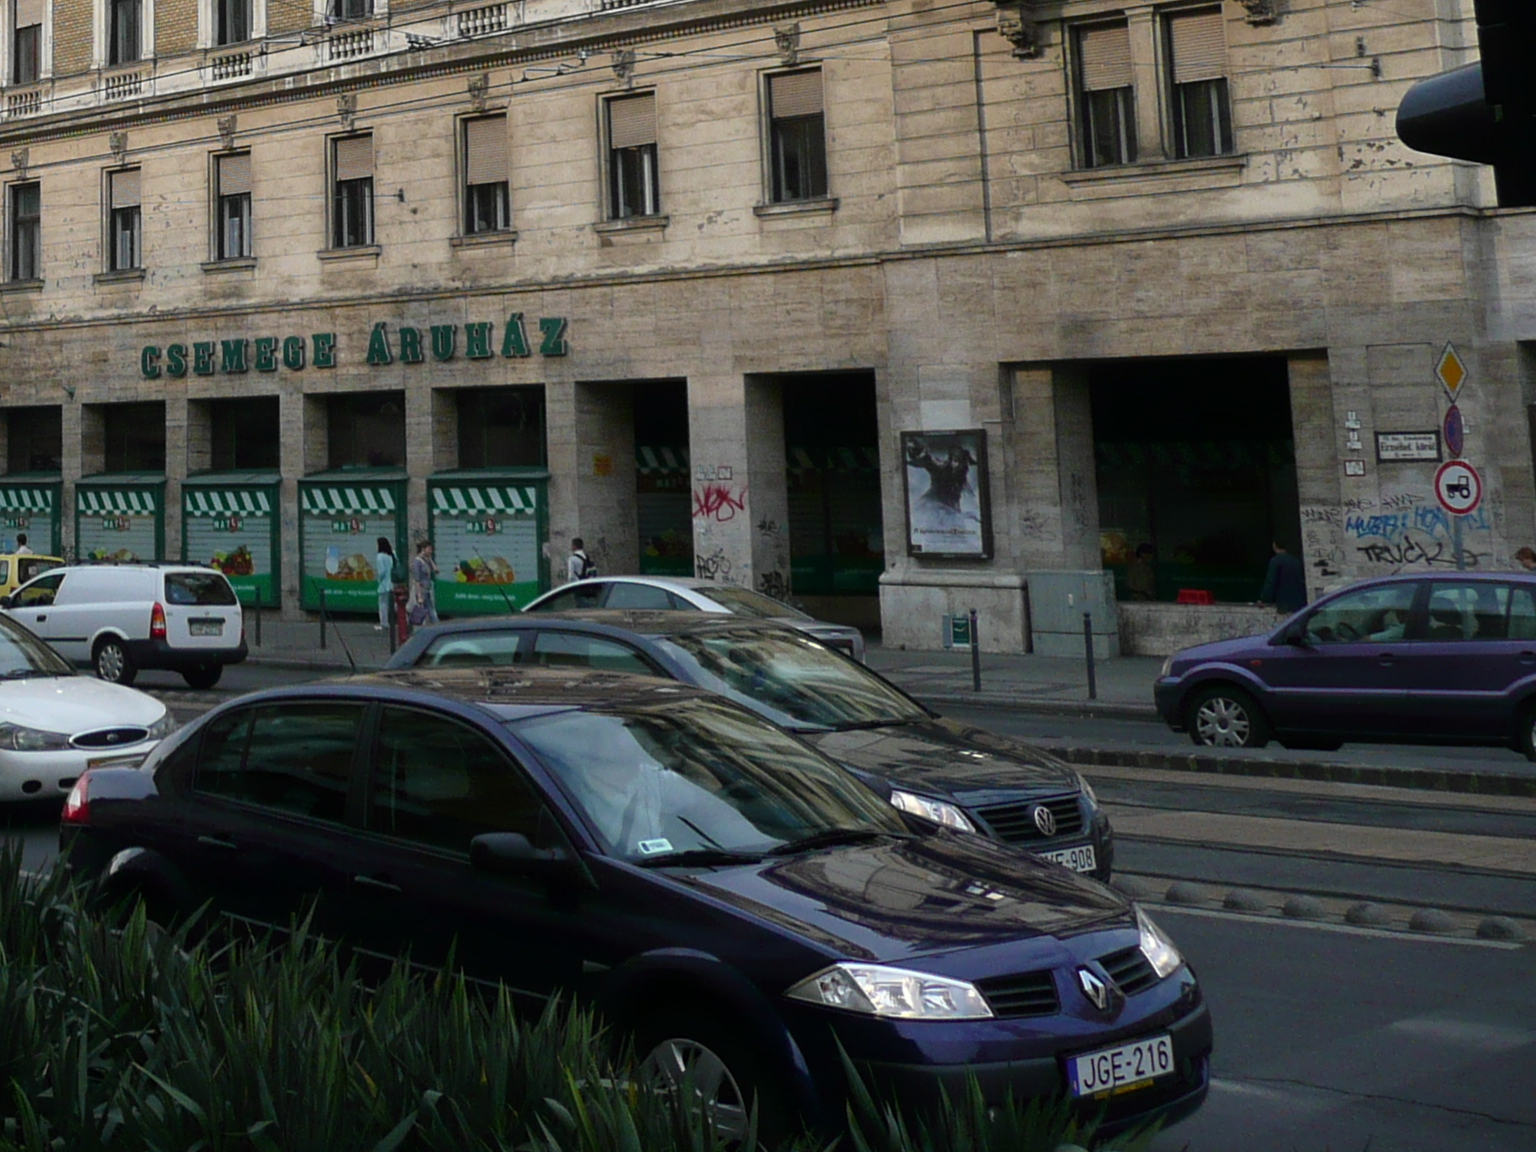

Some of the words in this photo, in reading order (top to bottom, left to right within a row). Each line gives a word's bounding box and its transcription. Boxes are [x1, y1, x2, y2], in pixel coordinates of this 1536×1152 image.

[141, 332, 337, 379] CSEMEGE
[366, 312, 567, 366] ÁRUHÁZ
[332, 518, 365, 534] MATCH
[466, 518, 502, 535] MATCH
[1083, 1040, 1169, 1089] JGE-216
